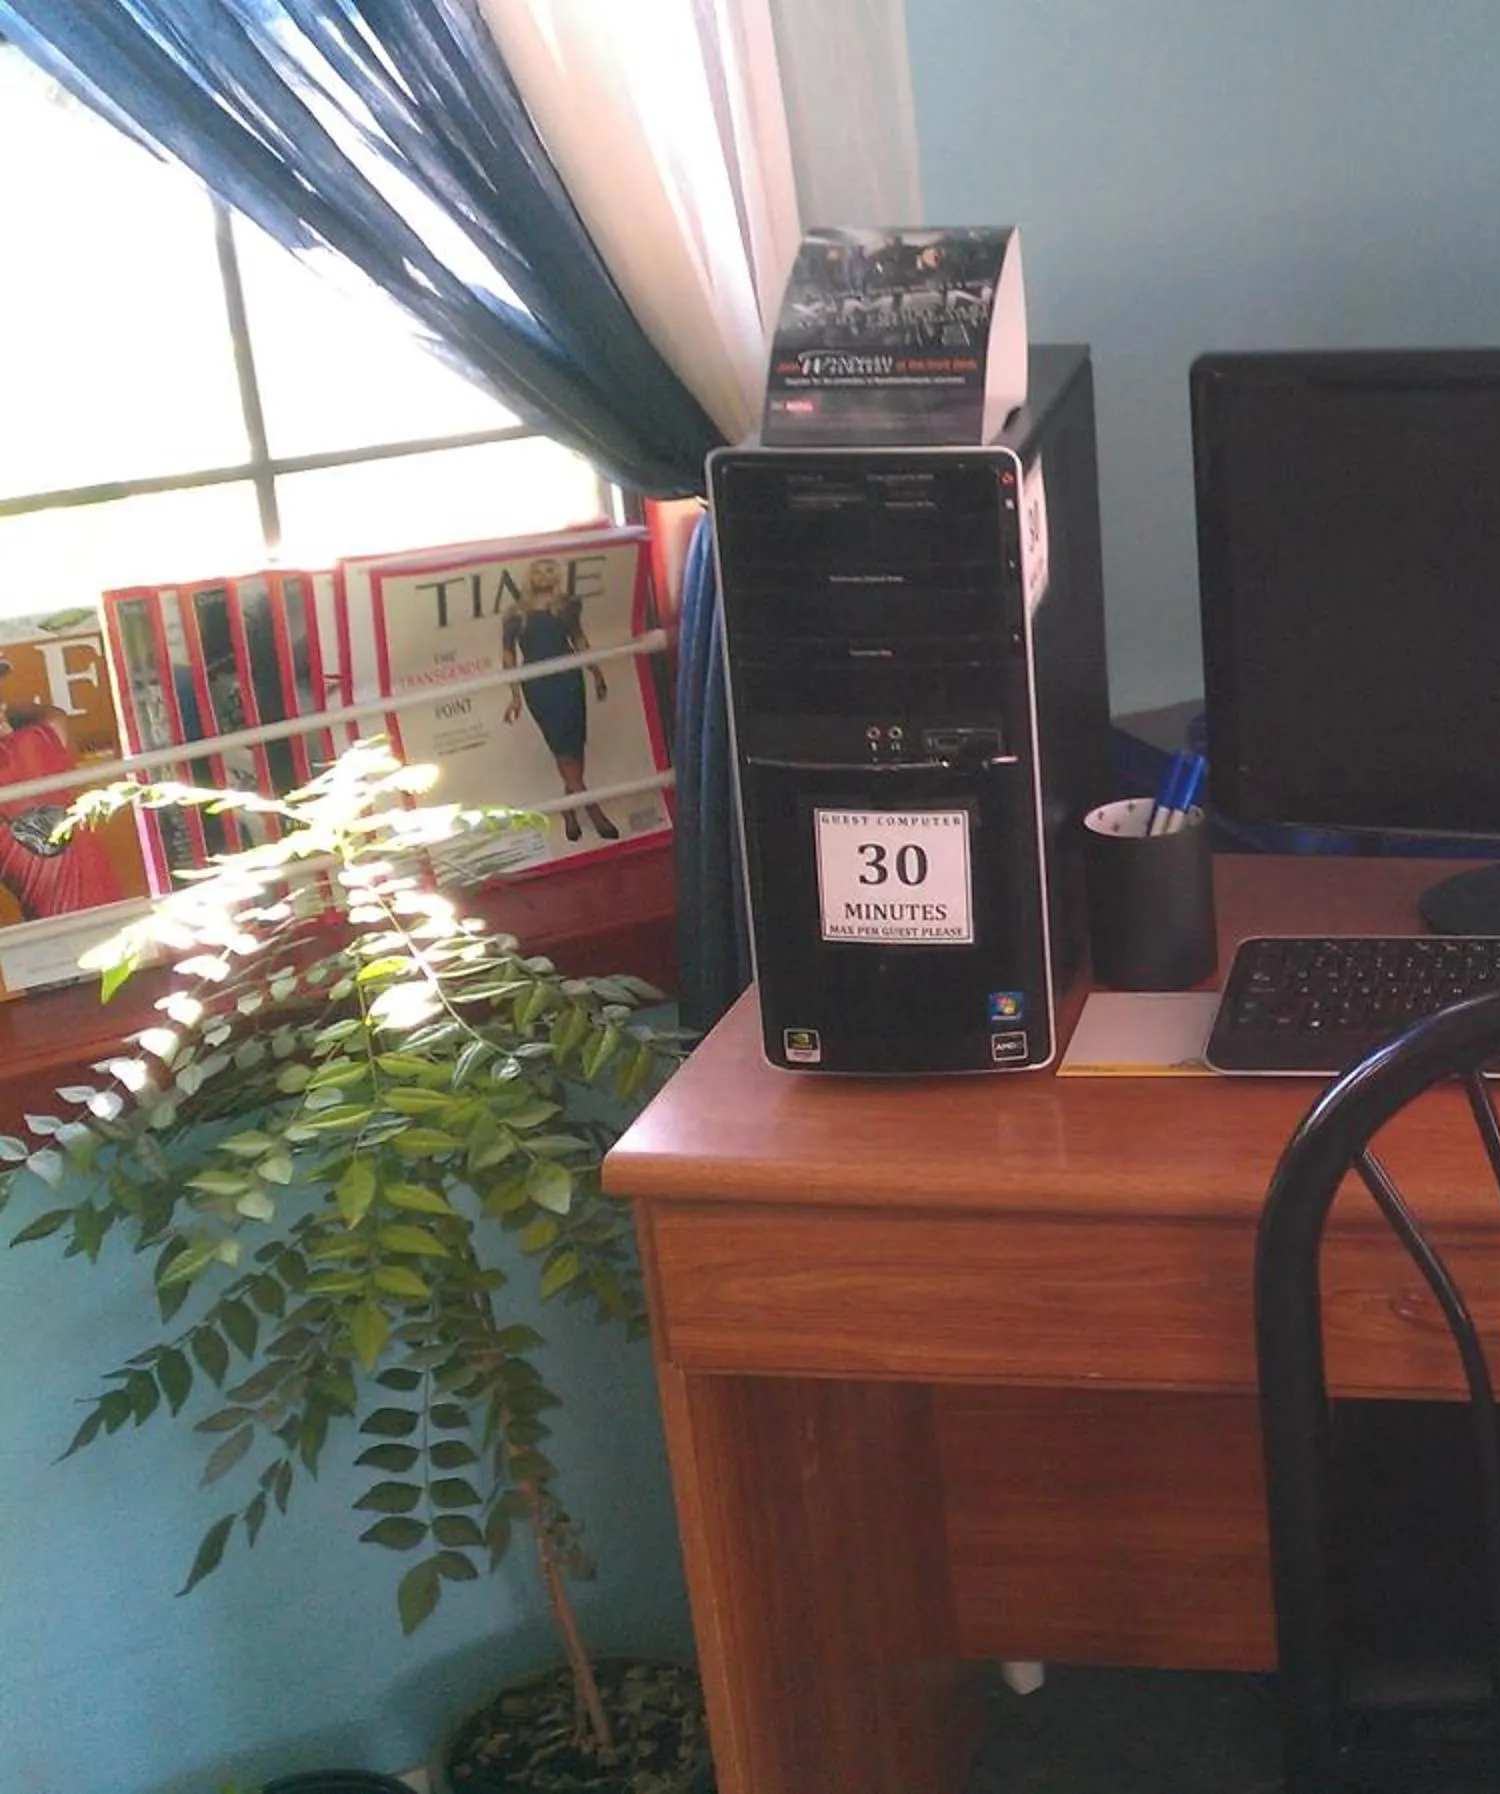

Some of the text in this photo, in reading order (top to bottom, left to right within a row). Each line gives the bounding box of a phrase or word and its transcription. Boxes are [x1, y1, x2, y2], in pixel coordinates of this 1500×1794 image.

[821, 815, 962, 827] GUEST COMPUTER
[857, 843, 928, 886] 30
[844, 902, 948, 922] MINUTES
[829, 925, 963, 937] MAX PER GUEST PLEASE
